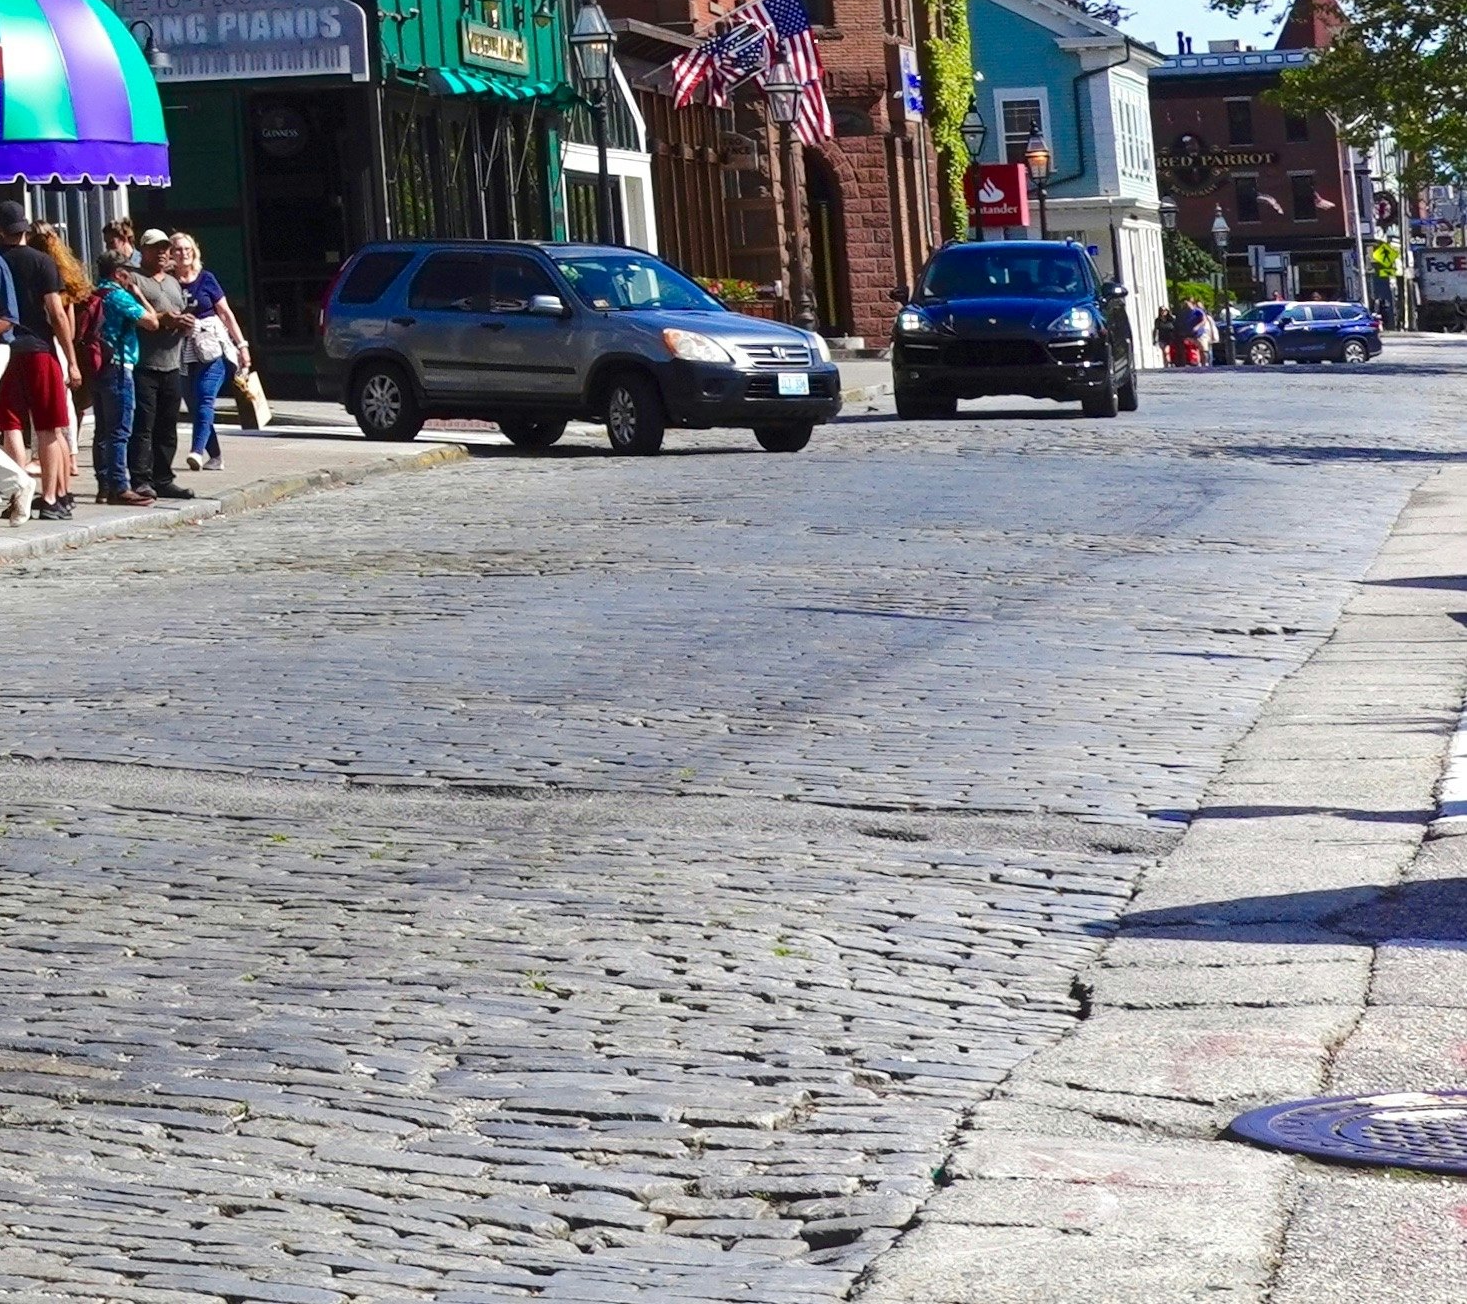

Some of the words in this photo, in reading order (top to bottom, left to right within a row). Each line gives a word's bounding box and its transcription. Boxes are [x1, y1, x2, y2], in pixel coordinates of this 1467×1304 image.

[217, 5, 342, 43] PIANOS
[1156, 156, 1193, 168] RED
[1201, 152, 1275, 167] PARROT
